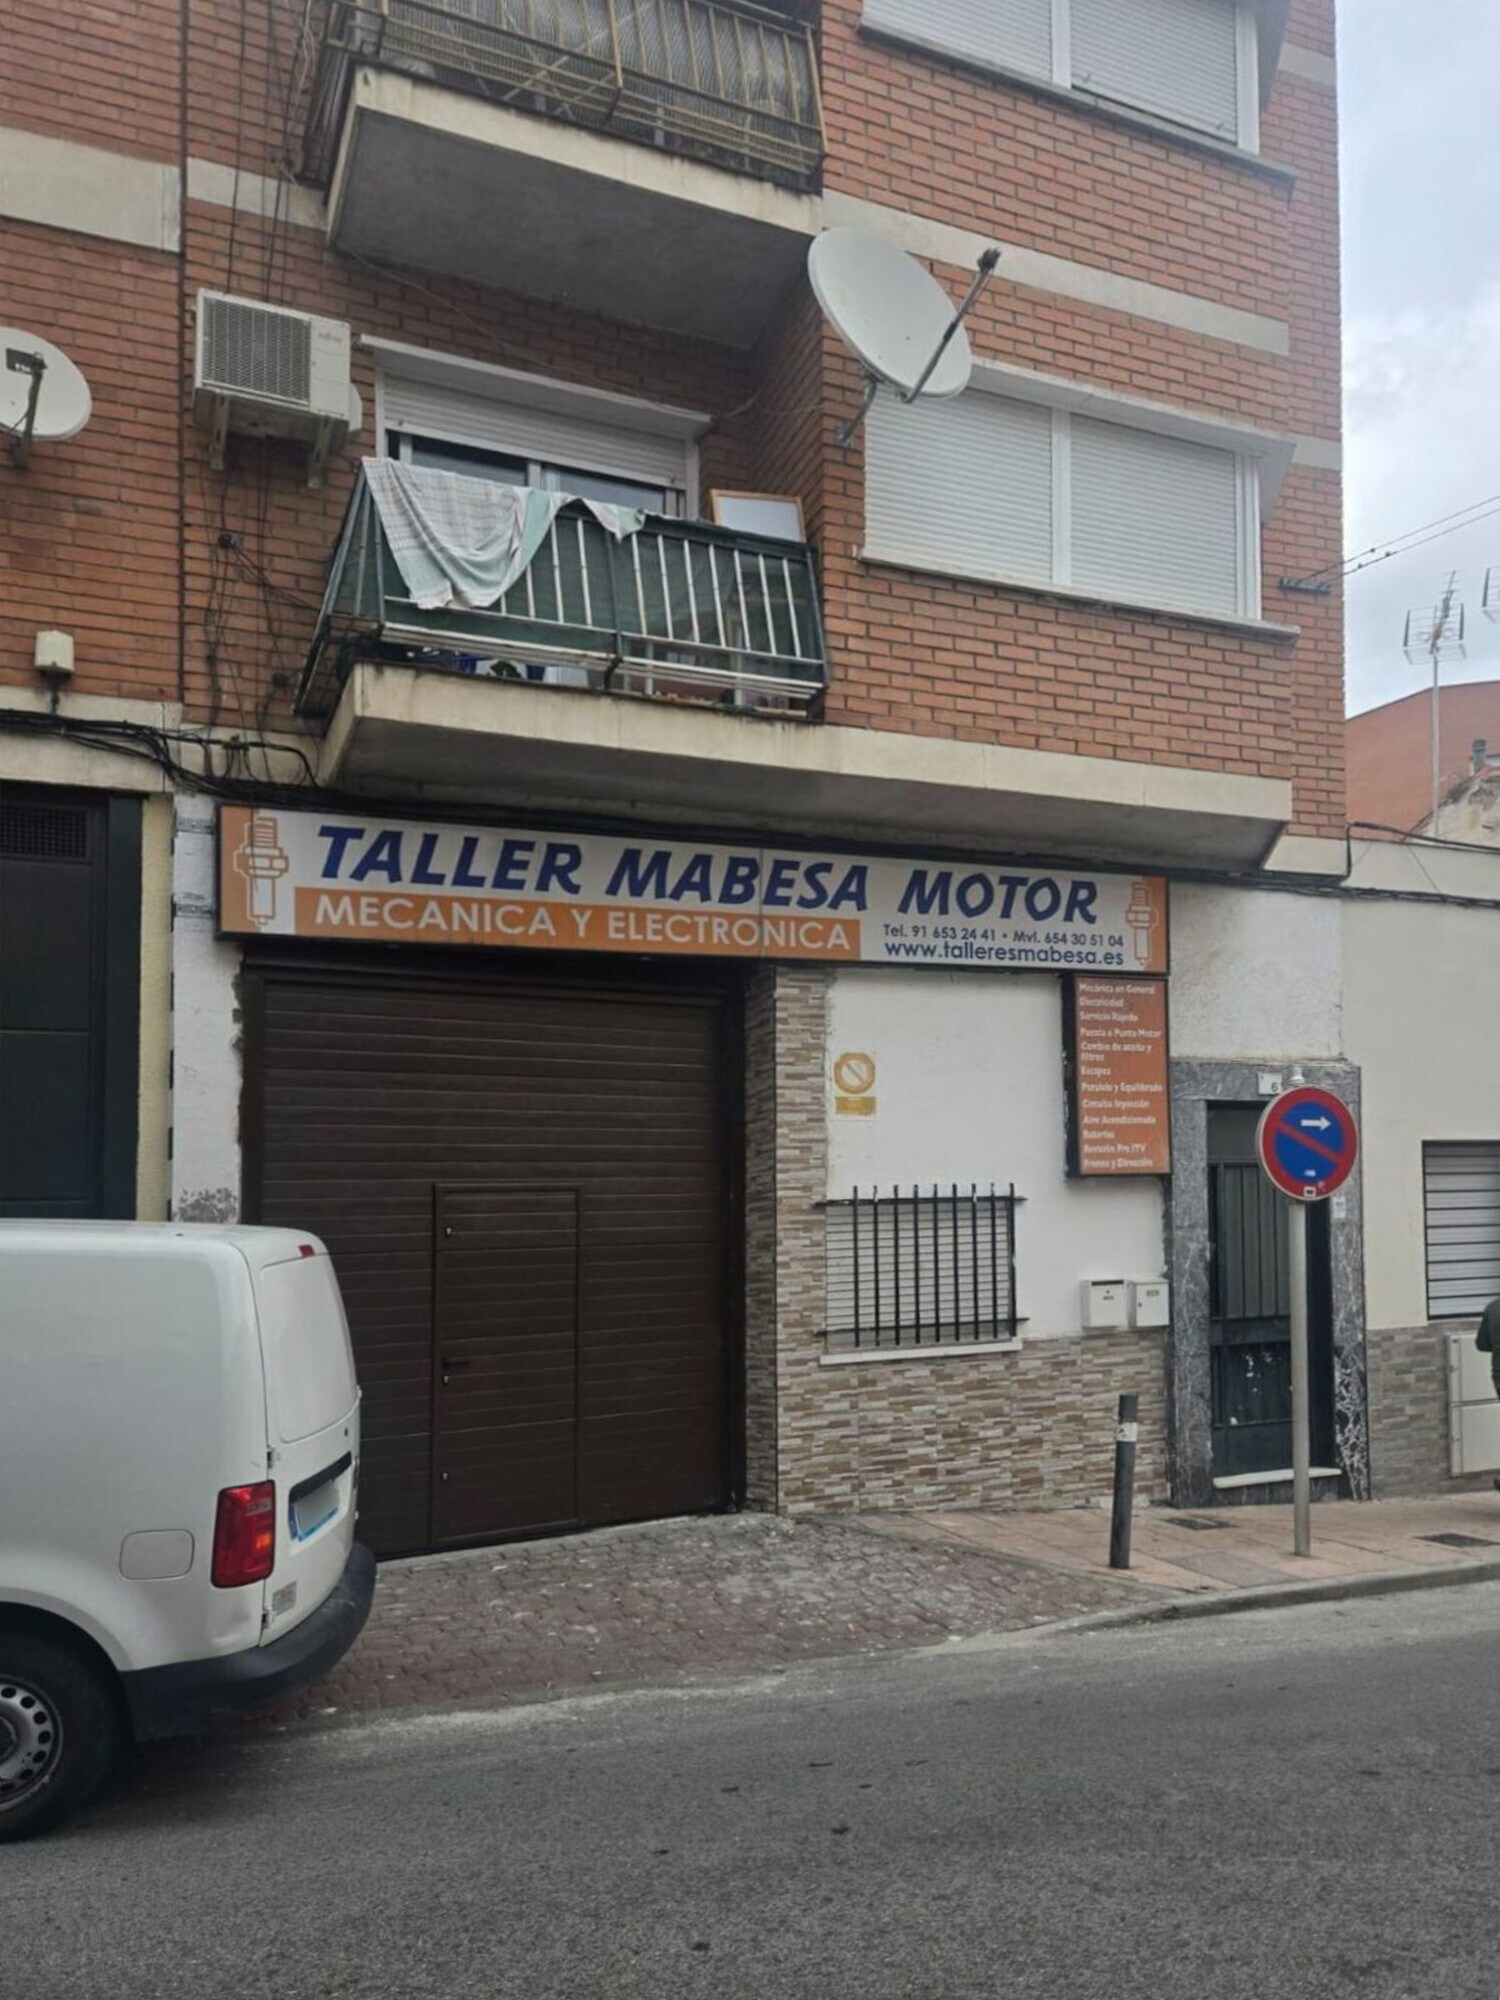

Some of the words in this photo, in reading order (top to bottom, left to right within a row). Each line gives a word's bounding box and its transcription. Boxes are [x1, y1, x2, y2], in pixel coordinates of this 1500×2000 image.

[318, 825, 582, 895] TALLER
[605, 848, 868, 912] MABESA
[898, 869, 1098, 924] MOTOR
[315, 895, 556, 937] MECANICA
[571, 909, 592, 938] Y
[608, 911, 850, 950] ELECTRONICA
[883, 924, 908, 938] Tel.
[912, 925, 927, 938] 91
[933, 927, 957, 940] 653
[961, 928, 977, 940] 24
[981, 929, 996, 941] 41
[1013, 930, 1041, 943] Mvl.
[1045, 932, 1067, 945] 654
[1071, 934, 1087, 945] 30
[1090, 934, 1103, 946] 51
[1109, 935, 1124, 947] 04
[884, 941, 1124, 966] www.talleresmabesa.es
[1271, 1082, 1279, 1092] 6
